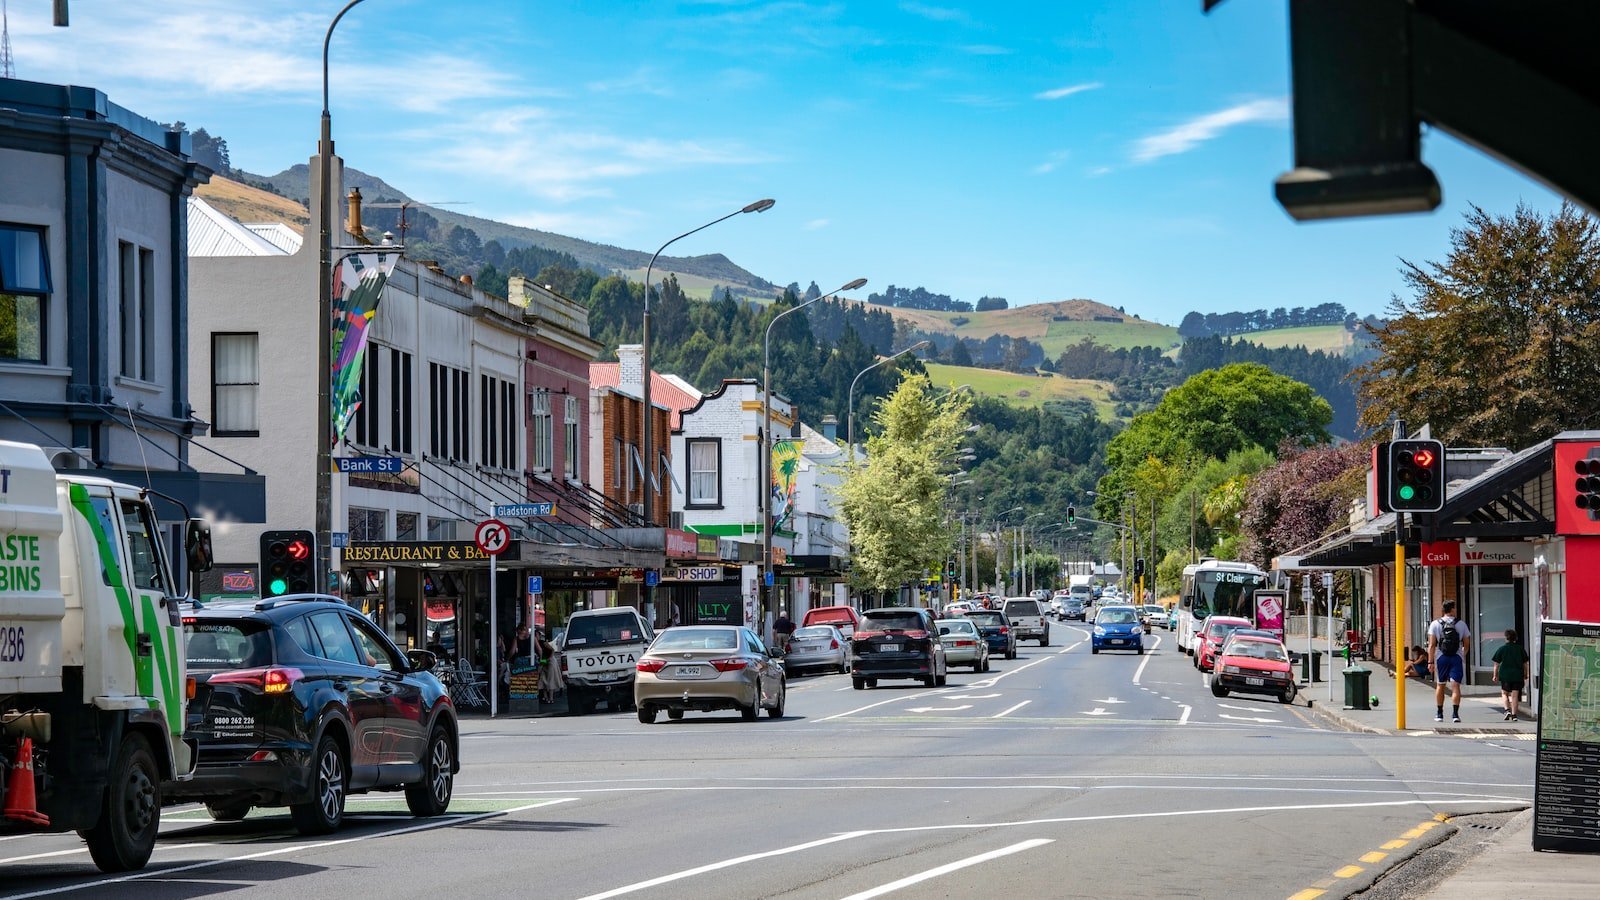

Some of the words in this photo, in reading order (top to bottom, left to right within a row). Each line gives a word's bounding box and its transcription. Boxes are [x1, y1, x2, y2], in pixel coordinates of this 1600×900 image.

[341, 459, 372, 471] Bank
[378, 459, 392, 470] St
[498, 506, 538, 516] Gladstone
[540, 504, 550, 514] Rd
[345, 546, 444, 560] RESTAURANT
[448, 546, 460, 560] &
[1427, 552, 1450, 562] Cash
[1465, 552, 1516, 561] Westpac
[690, 568, 718, 580] SHOP
[1216, 572, 1224, 582] St
[1226, 573, 1244, 584] Clair
[223, 576, 254, 588] PIZZA
[576, 654, 635, 668] TOYOTA
